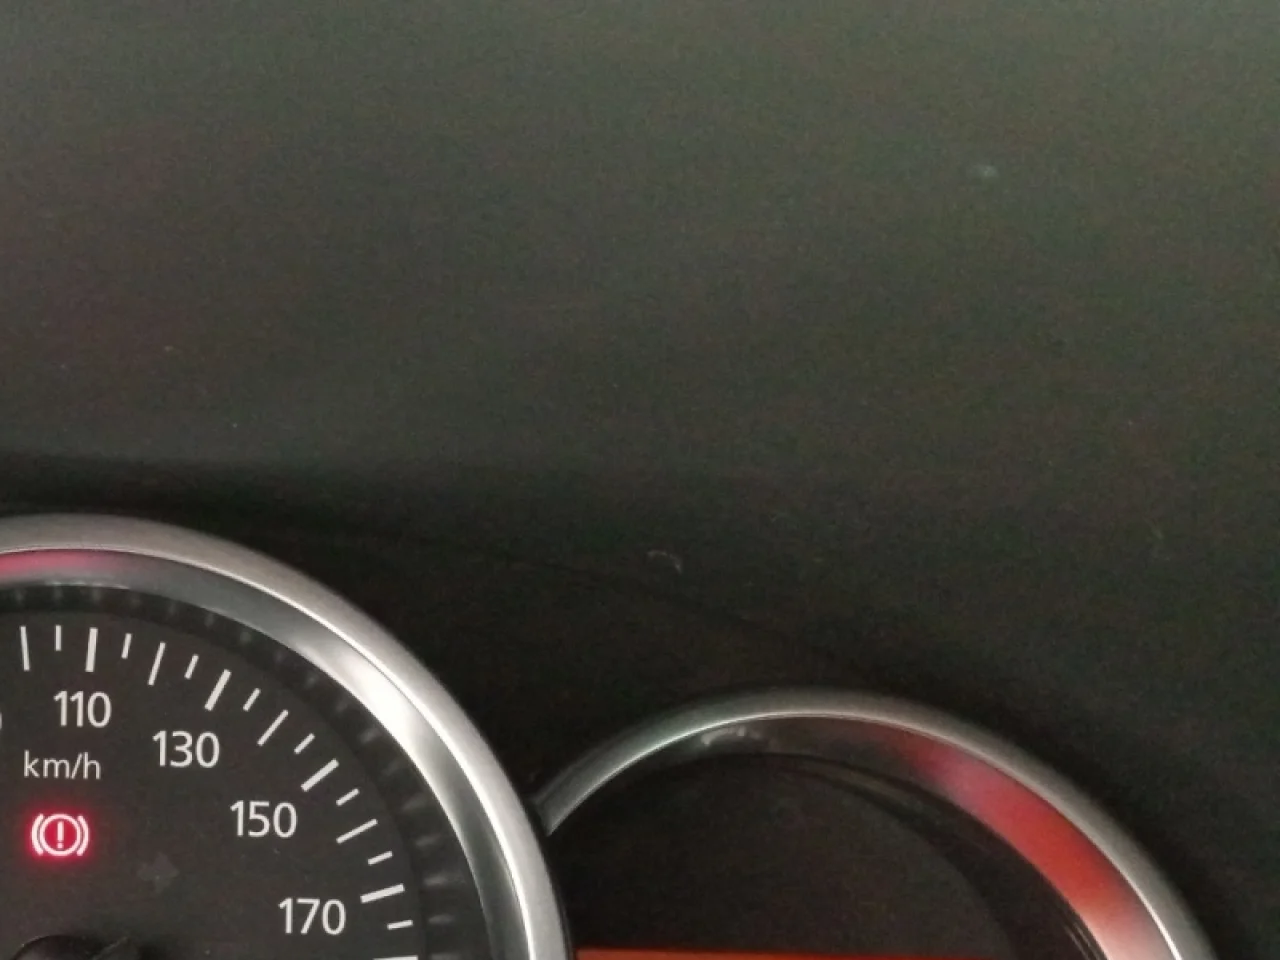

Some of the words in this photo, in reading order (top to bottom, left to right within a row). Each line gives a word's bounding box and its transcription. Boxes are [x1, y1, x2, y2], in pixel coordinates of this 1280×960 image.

[53, 690, 112, 728] 110
[23, 749, 101, 780] km/h
[152, 730, 220, 769] 130
[230, 799, 297, 838] 150
[278, 897, 346, 936] 170
